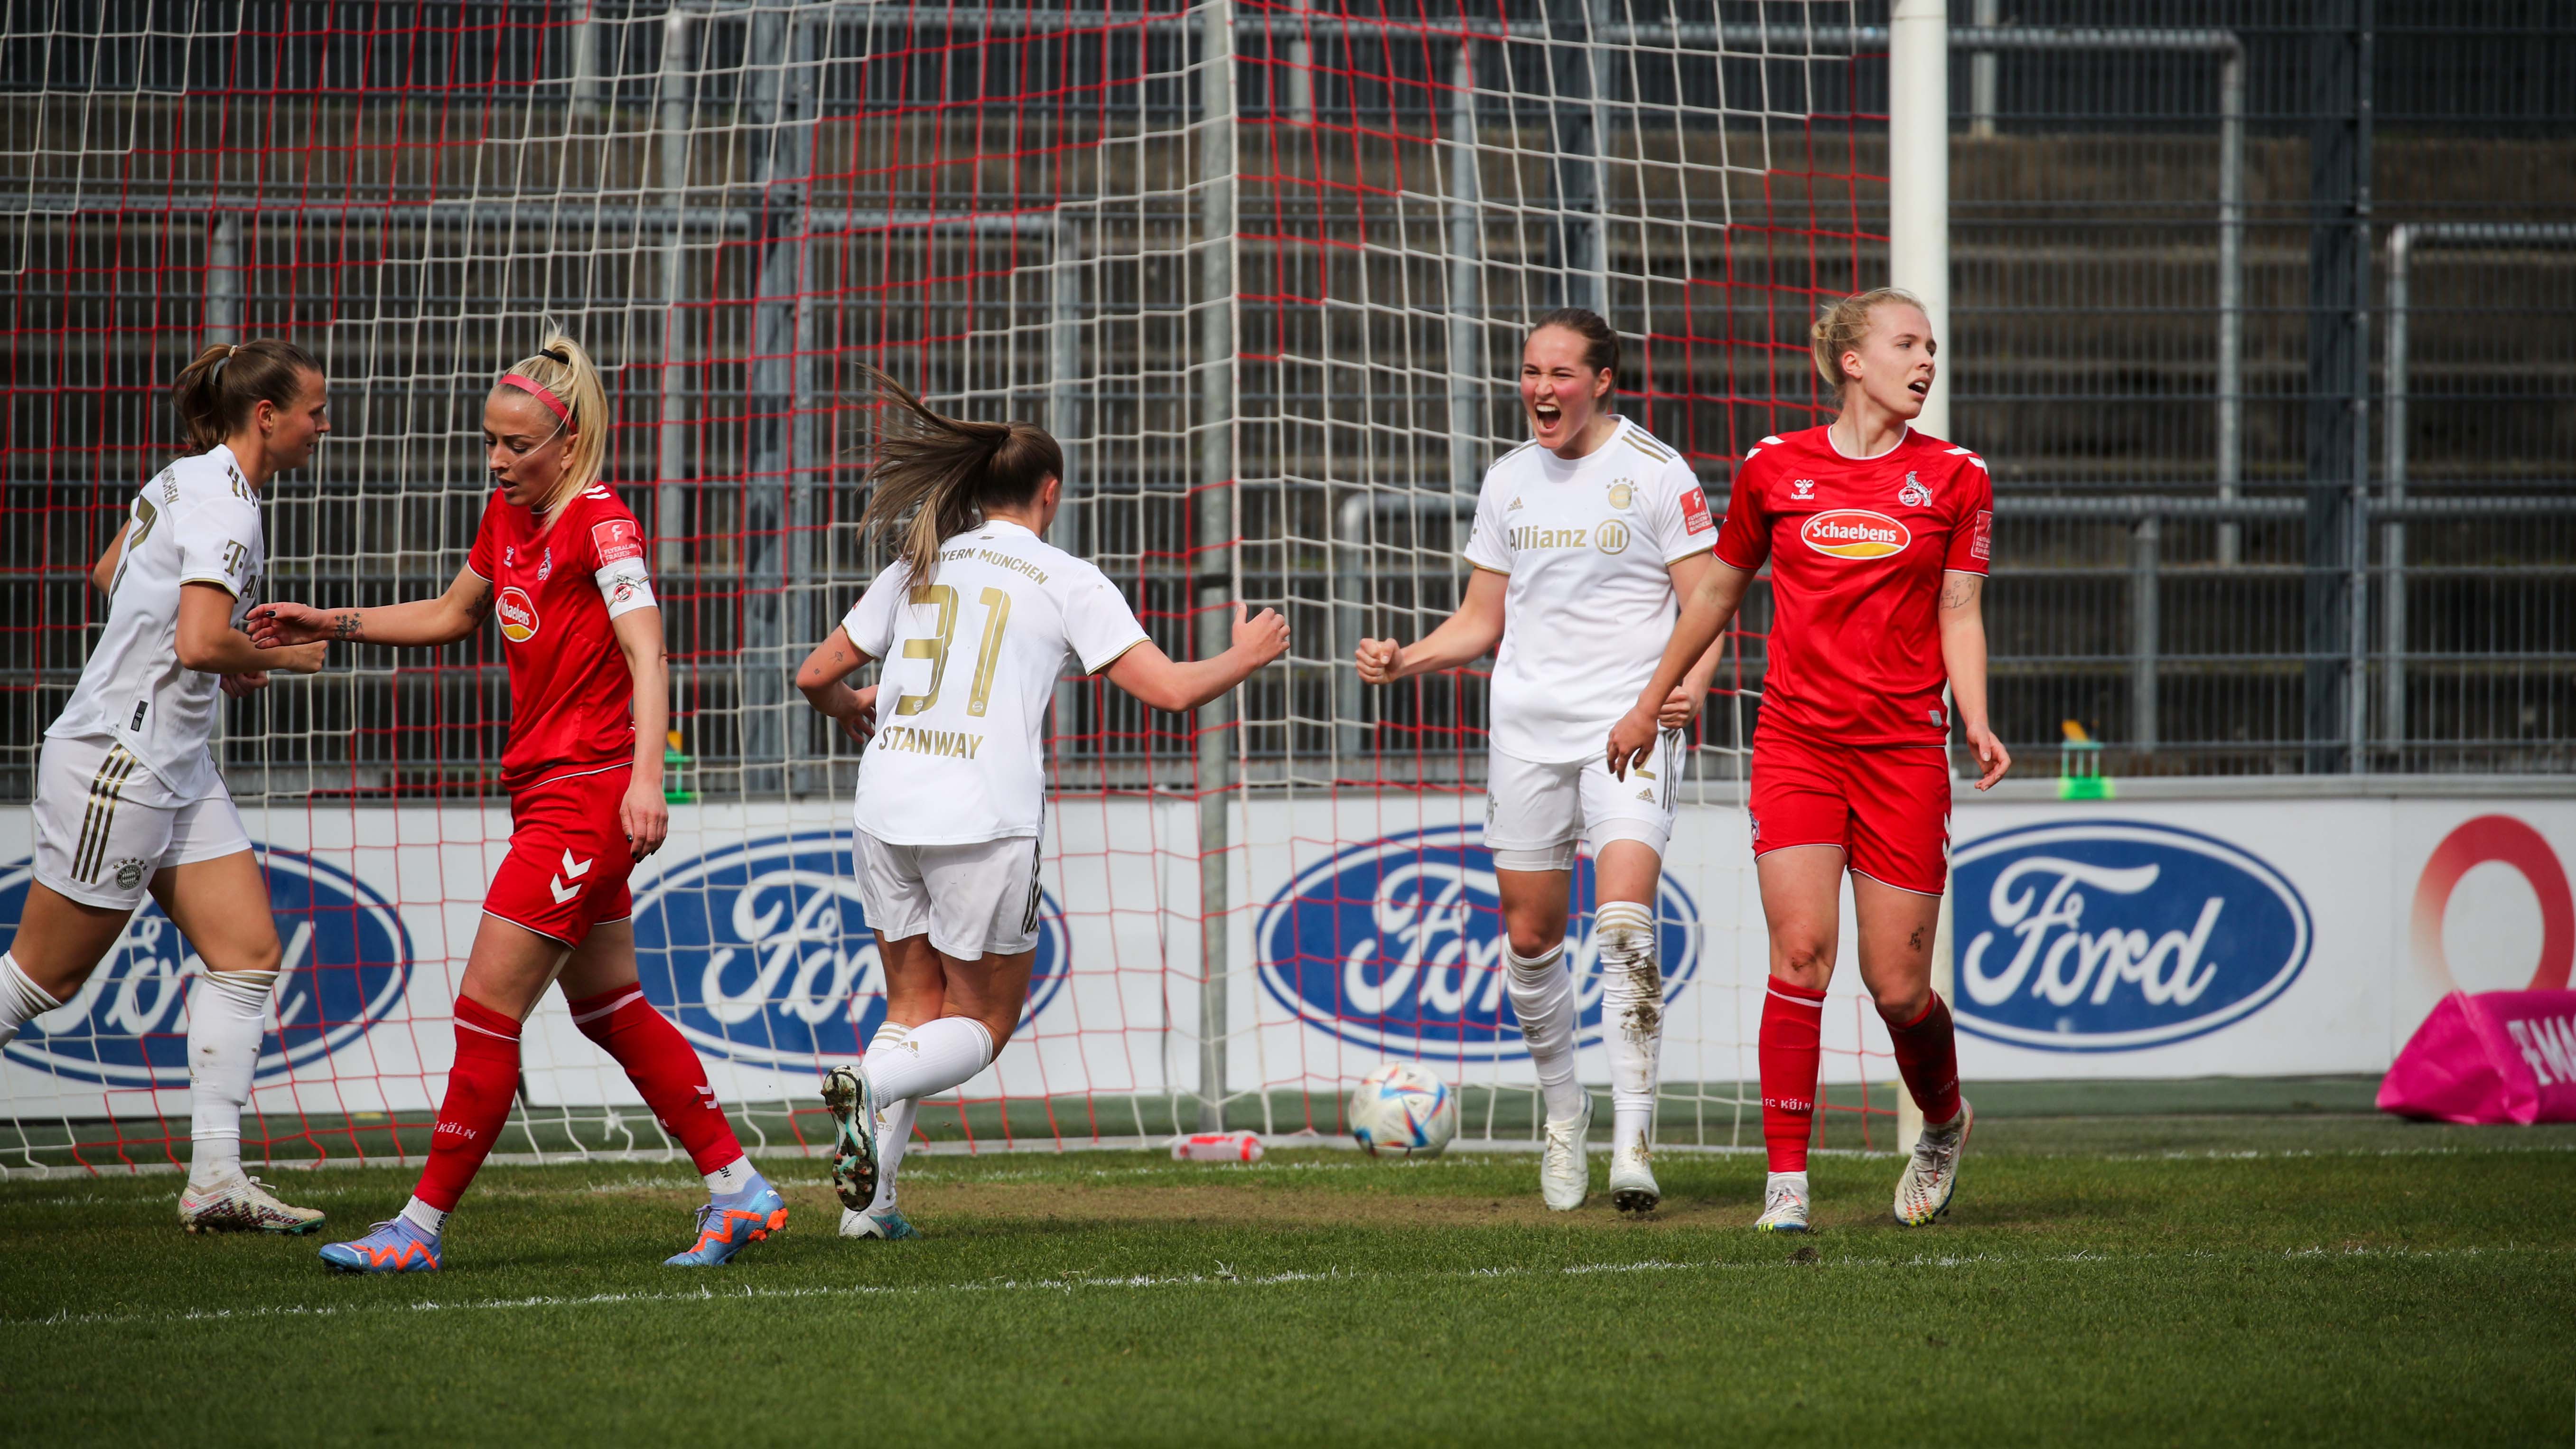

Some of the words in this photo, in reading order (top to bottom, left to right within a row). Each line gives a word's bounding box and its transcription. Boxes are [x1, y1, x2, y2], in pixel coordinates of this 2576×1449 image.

[1509, 525, 1587, 553] Allianz
[1812, 521, 1896, 542] Schaebens
[978, 549, 1048, 585] MÜNCHEN
[895, 584, 1011, 717] 31
[879, 726, 984, 759] STANWAY
[1963, 857, 2224, 1007] Ford
[1781, 1098, 1811, 1111] KÖLN
[437, 1122, 476, 1140] KÖLN
